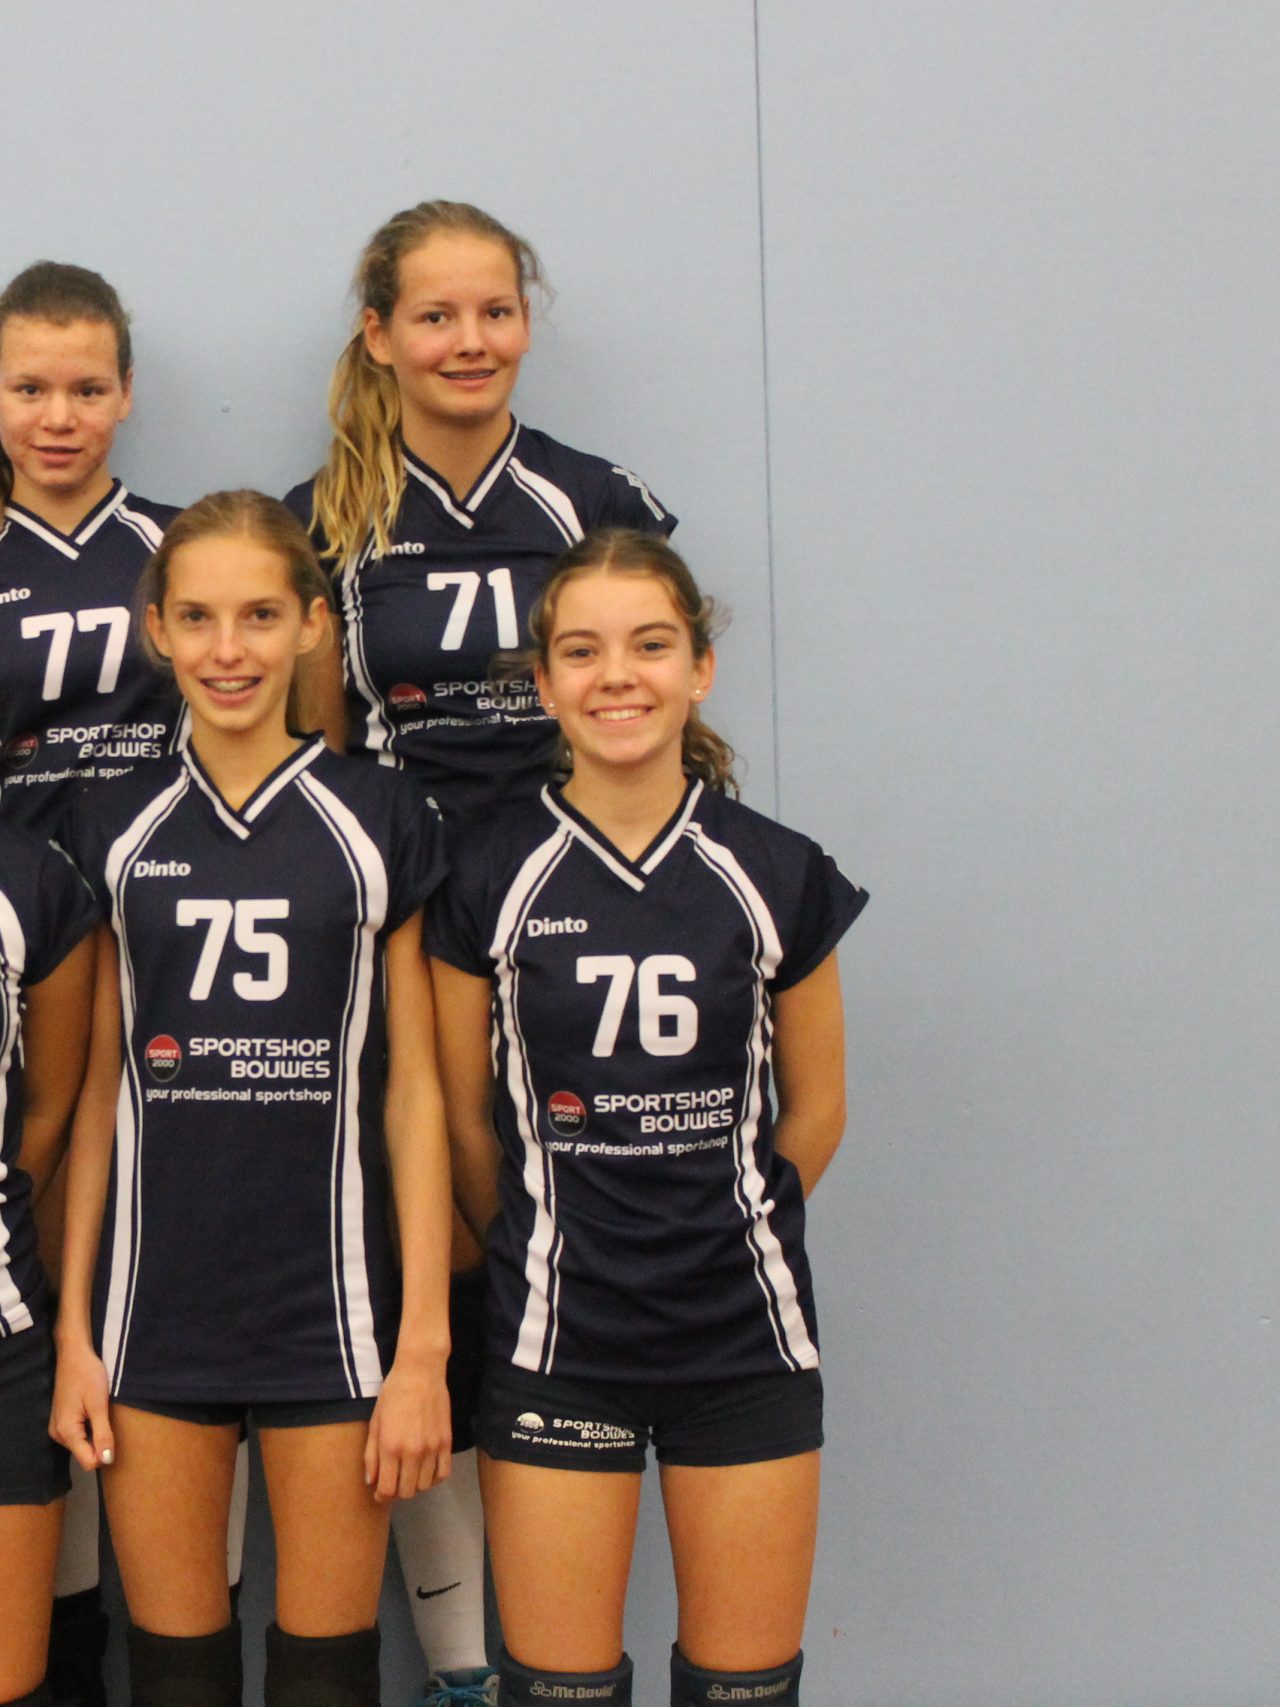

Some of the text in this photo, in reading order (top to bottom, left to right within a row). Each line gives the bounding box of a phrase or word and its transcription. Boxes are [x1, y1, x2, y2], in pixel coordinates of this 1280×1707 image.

[371, 542, 425, 560] nto
[427, 568, 519, 650] 71
[21, 606, 130, 700] 77
[434, 680, 536, 697] SPORTSH
[46, 724, 166, 744] SPORTSHOP
[400, 720, 425, 734] your
[79, 742, 162, 758] BOUWES
[134, 860, 191, 878] Dinto
[527, 916, 588, 937] Dinto
[176, 898, 289, 1001] 75
[576, 954, 698, 1058] 76
[149, 1050, 178, 1058] SPORT
[189, 1038, 330, 1057] SPORTSHOP
[152, 1059, 174, 1068] 2000
[231, 1060, 330, 1078] BOUWES
[146, 1087, 331, 1104] your professional sportshop
[594, 1088, 734, 1112] SPORTSHOP
[551, 1104, 581, 1114] SPORT
[555, 1114, 580, 1122] 2000
[641, 1109, 733, 1133] BOUWES
[576, 1142, 662, 1156] professional
[668, 1136, 728, 1156] sportshop
[512, 1432, 530, 1440] your
[532, 1436, 590, 1448] professional
